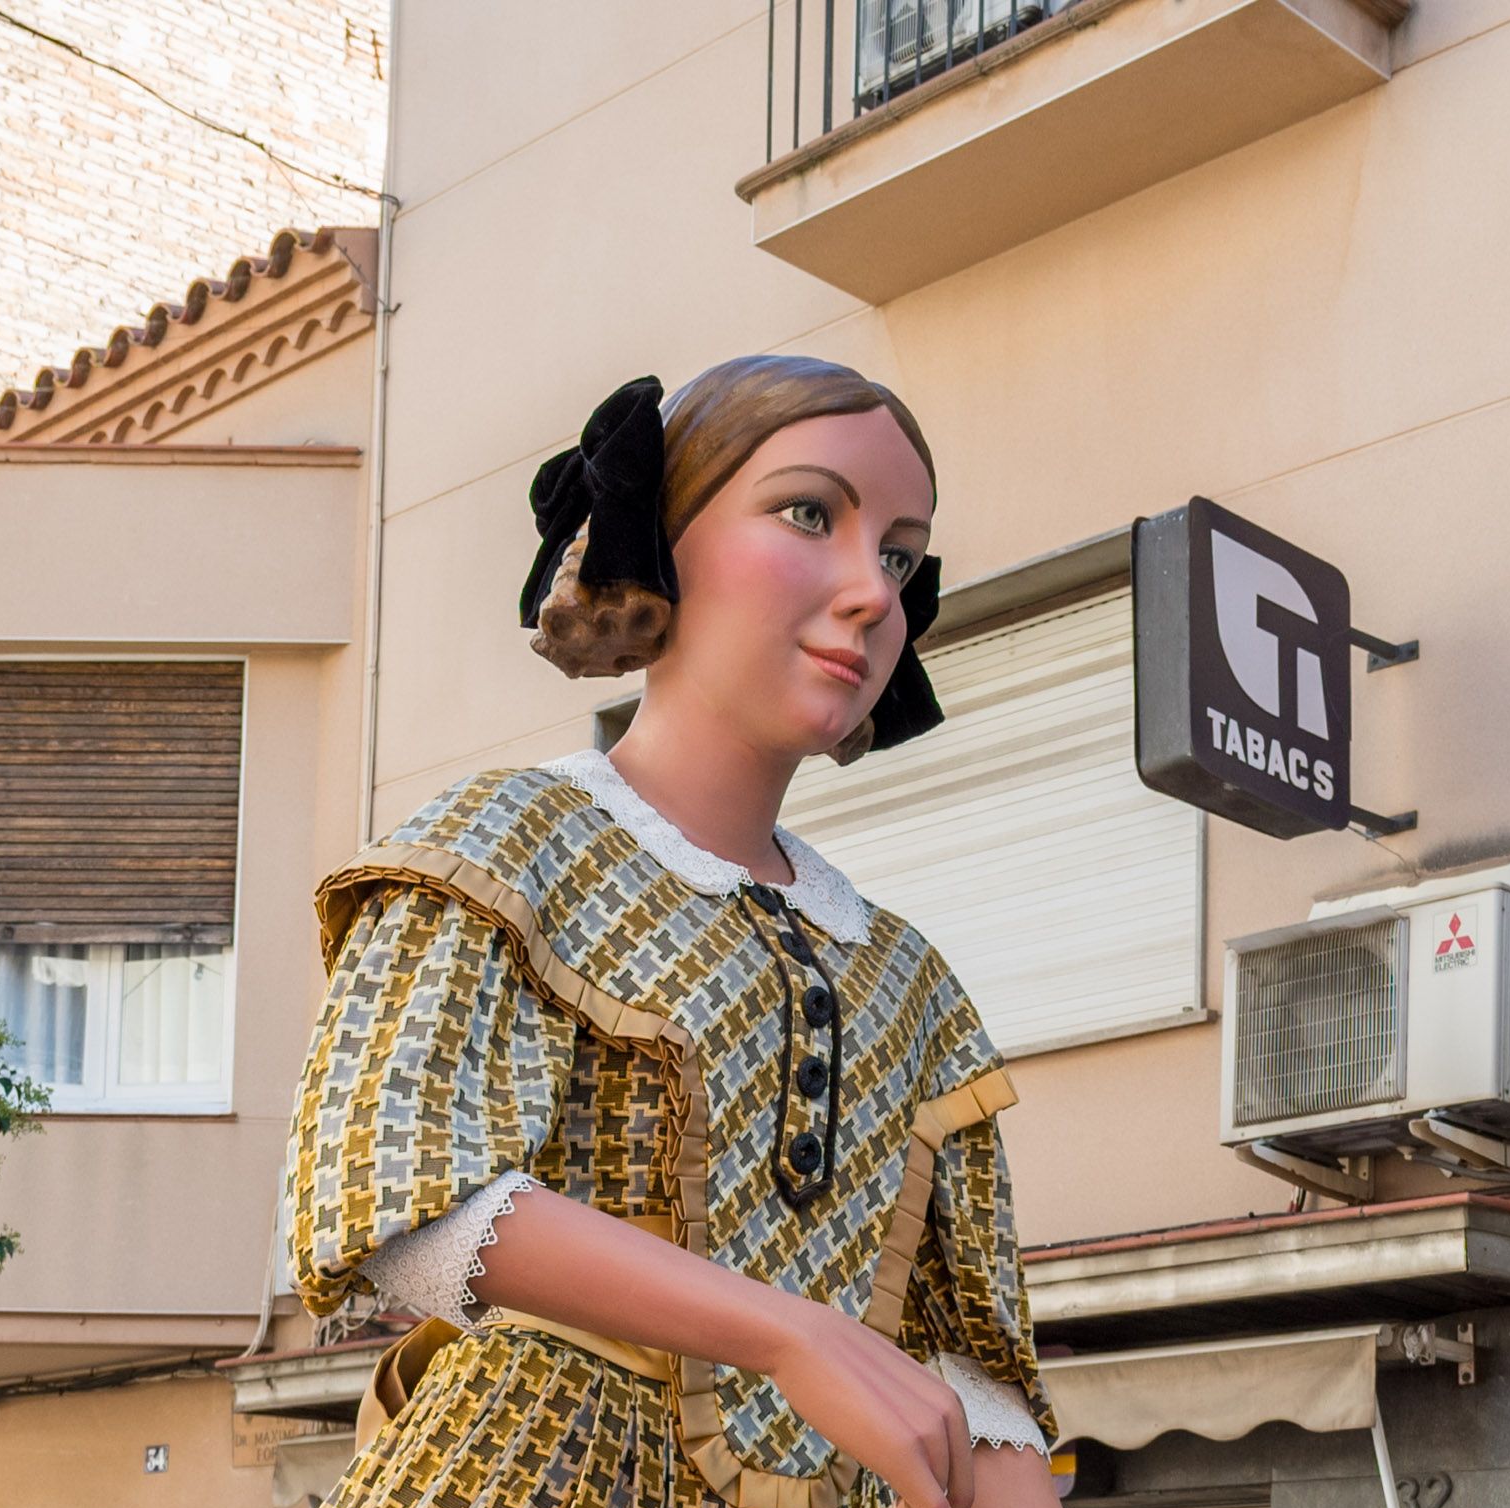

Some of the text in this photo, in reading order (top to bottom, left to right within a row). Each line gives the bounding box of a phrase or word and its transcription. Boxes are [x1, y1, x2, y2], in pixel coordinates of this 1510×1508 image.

[1206, 706, 1334, 801] TABACS
[1434, 949, 1476, 964] MITSUBISHI
[1434, 958, 1470, 973] ELECTRIC
[147, 1447, 167, 1472] 34
